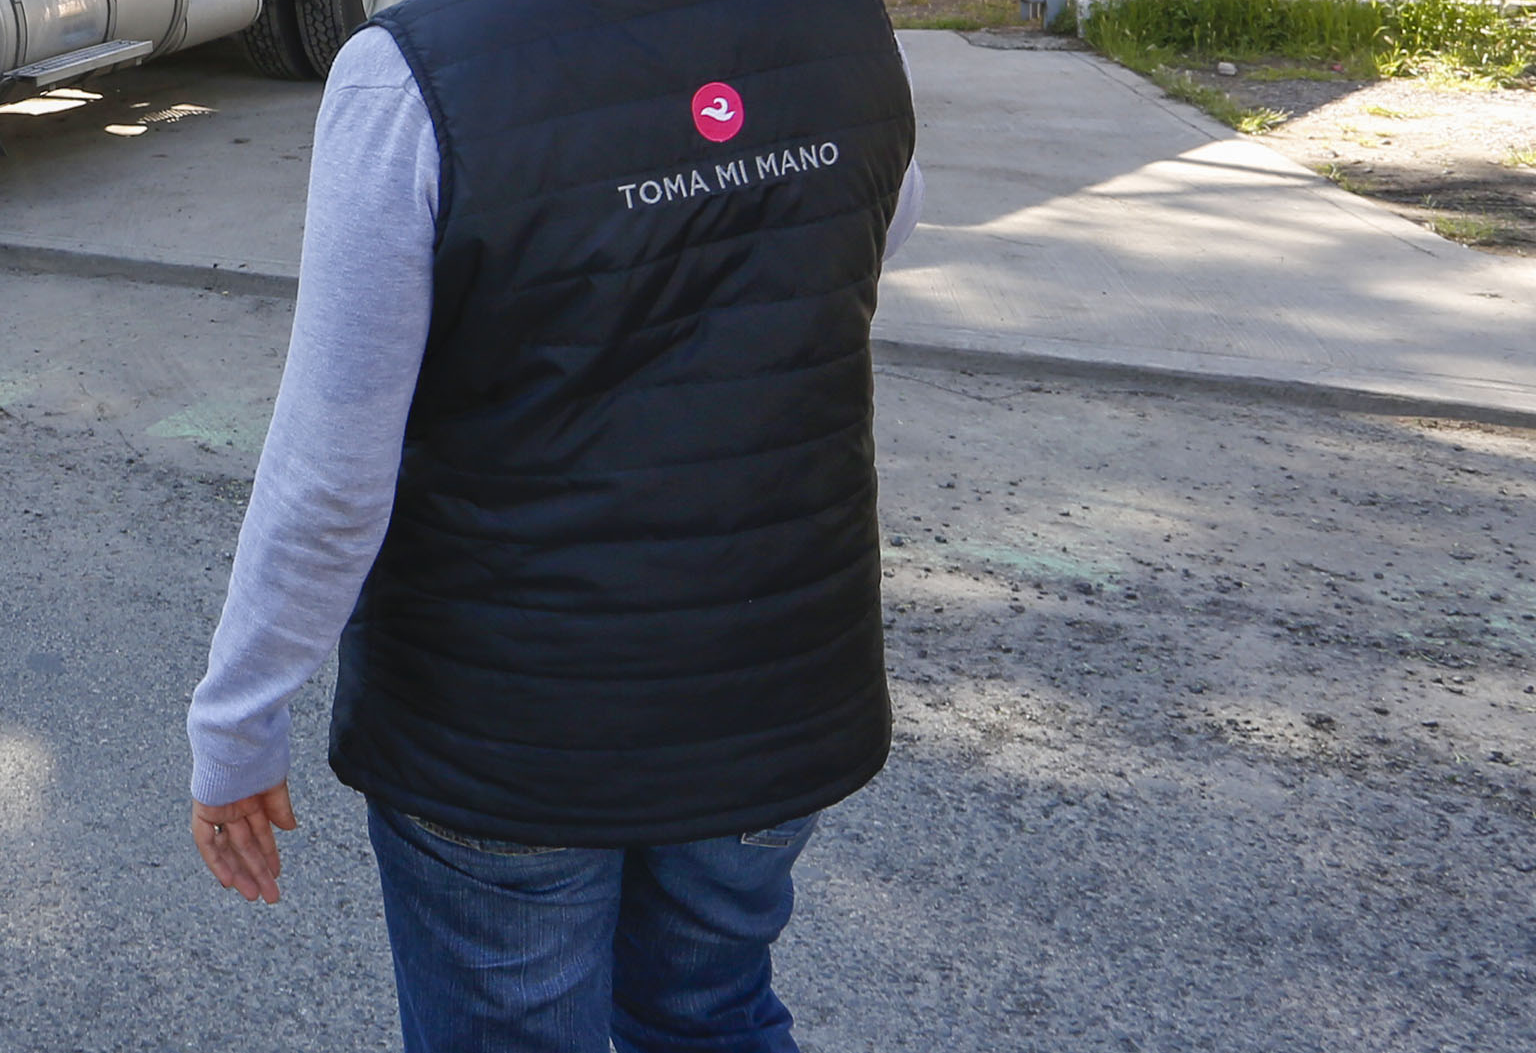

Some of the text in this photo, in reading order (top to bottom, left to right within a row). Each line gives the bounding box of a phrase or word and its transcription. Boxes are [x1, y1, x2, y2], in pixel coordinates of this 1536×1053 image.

[618, 142, 839, 209] TOMA MI MANO
